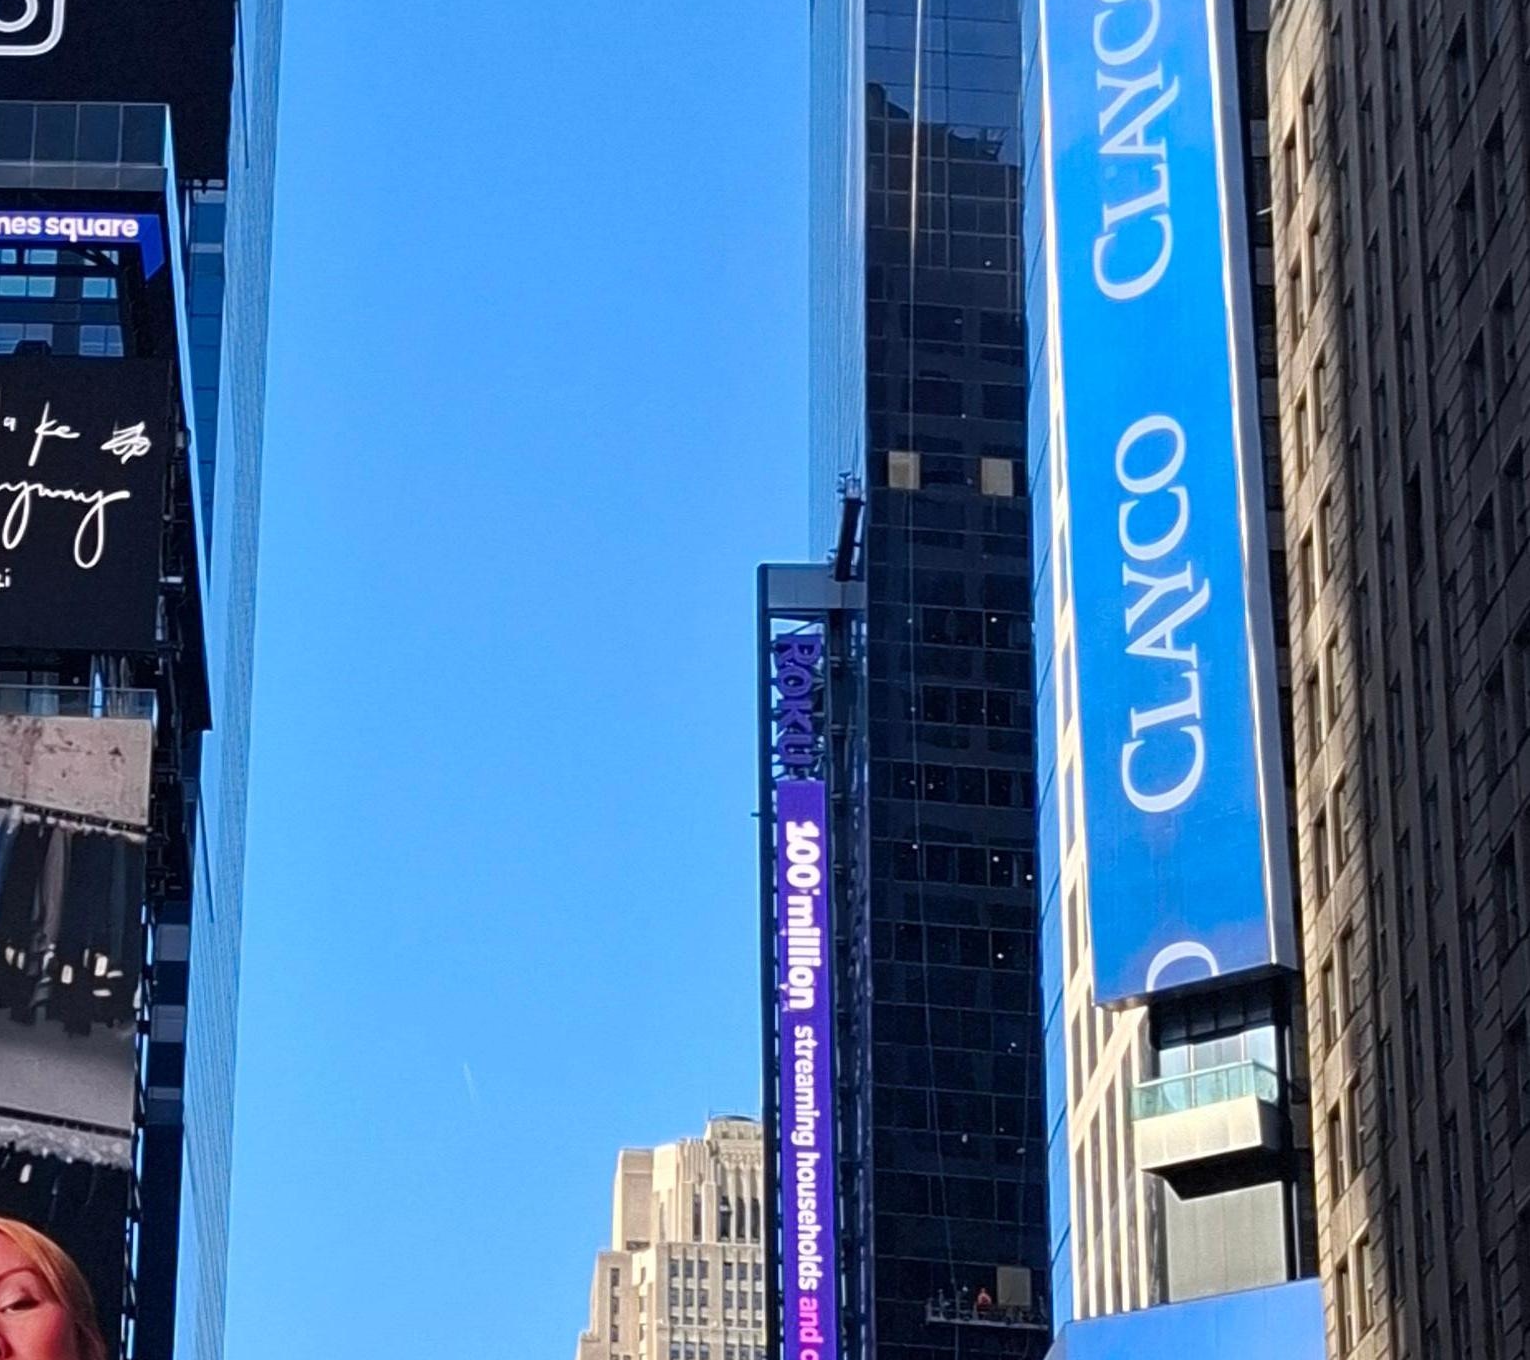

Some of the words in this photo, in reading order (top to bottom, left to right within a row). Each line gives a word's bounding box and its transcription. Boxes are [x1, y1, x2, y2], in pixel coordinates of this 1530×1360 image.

[45, 217, 139, 243] square
[1114, 414, 1210, 813] CLAYCO
[785, 821, 821, 889] 100
[785, 892, 820, 1010] million
[790, 1024, 820, 1148] streaming
[794, 1152, 821, 1291] households
[798, 1296, 825, 1342] and
